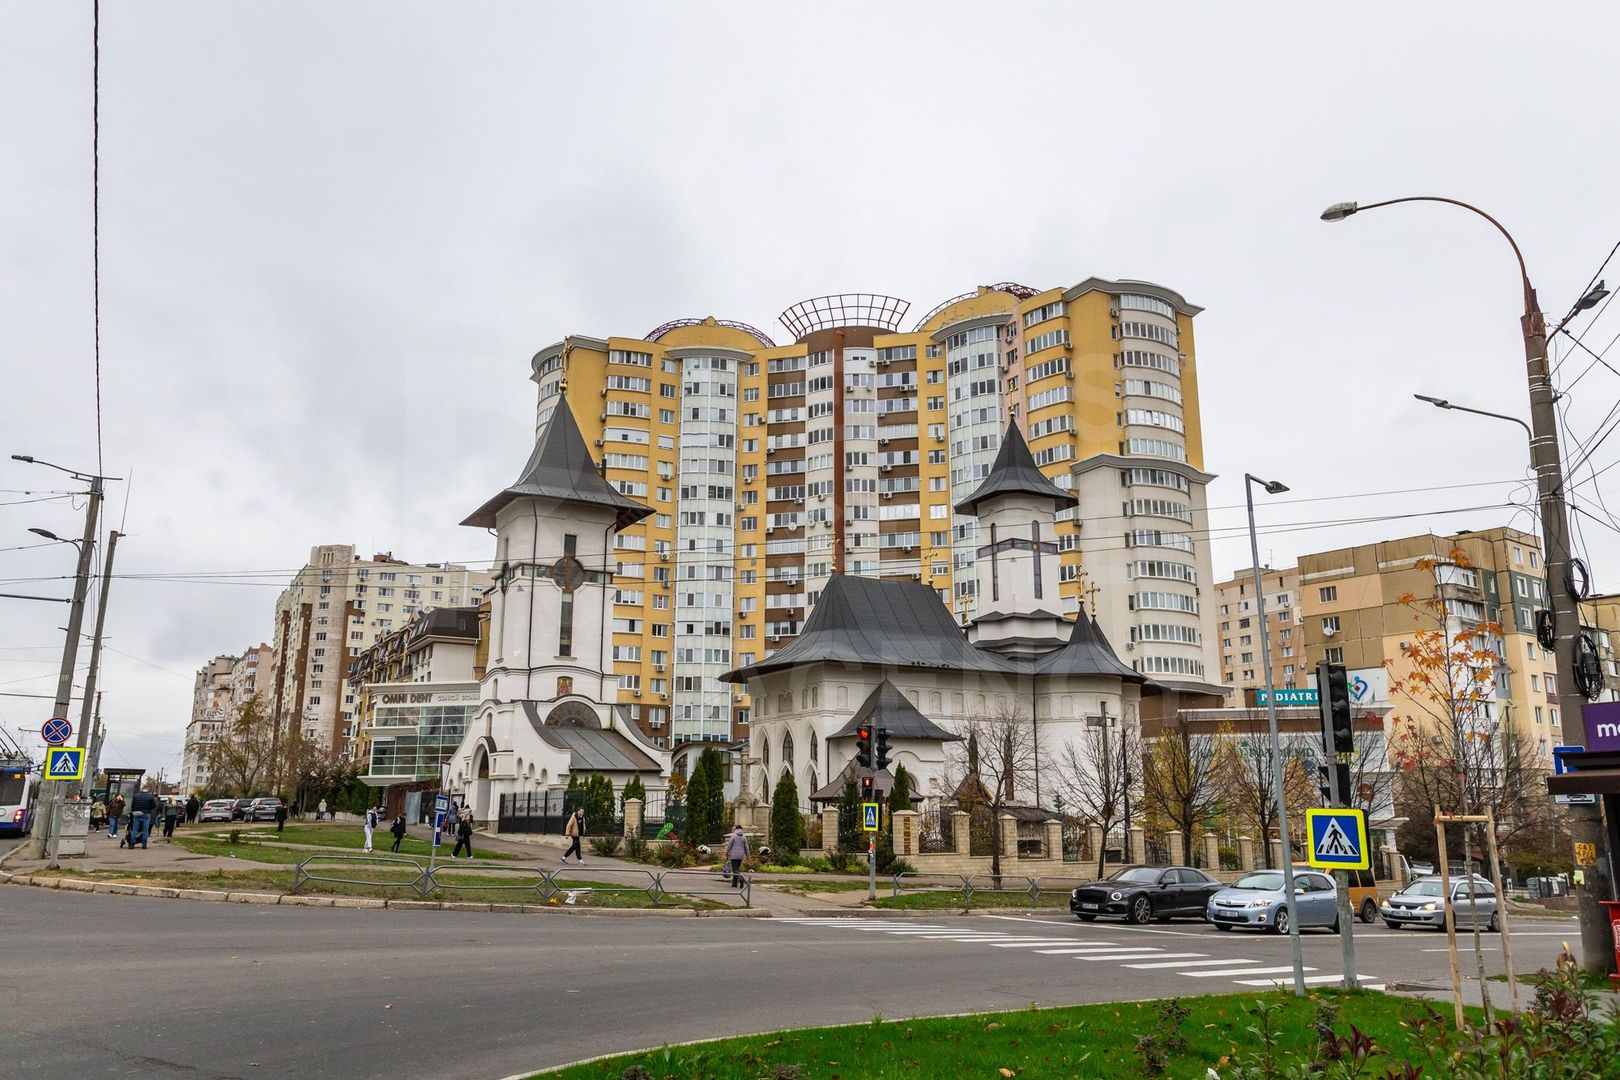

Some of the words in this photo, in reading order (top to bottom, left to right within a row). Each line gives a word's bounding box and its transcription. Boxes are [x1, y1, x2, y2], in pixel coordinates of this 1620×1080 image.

[382, 693, 407, 704] OMNI
[410, 693, 433, 703] DENT
[1262, 693, 1318, 701] PDIATRI
